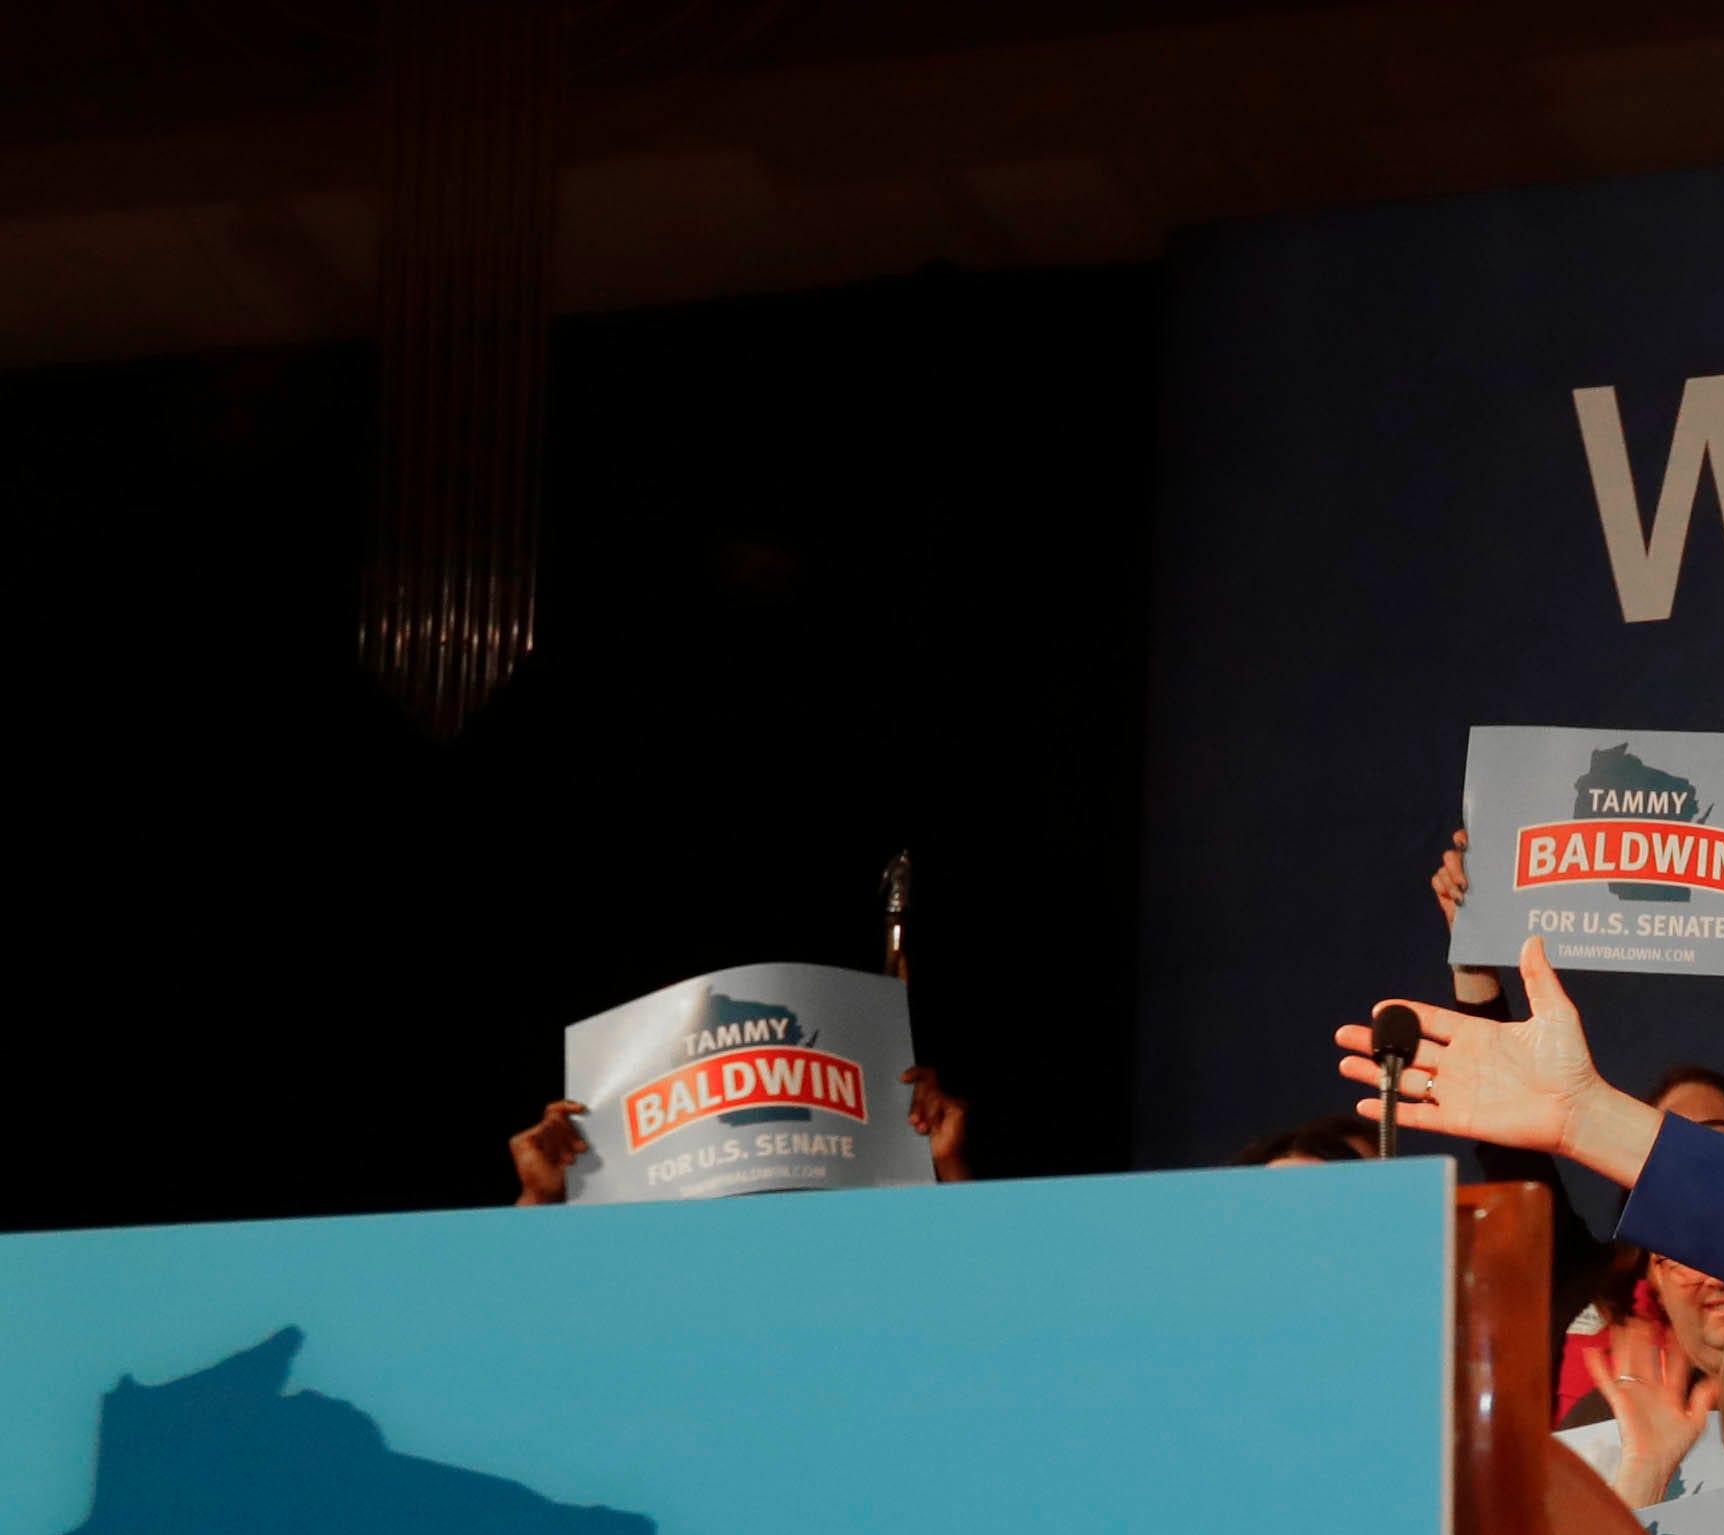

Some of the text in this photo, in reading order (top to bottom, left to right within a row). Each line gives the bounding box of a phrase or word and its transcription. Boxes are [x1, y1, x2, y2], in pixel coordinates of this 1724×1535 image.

[1589, 788, 1688, 814] TAMMY
[1527, 909, 1575, 932] FOR
[1582, 912, 1629, 936] U.S.
[1557, 944, 1696, 963] TAMMYBALDWIN.COM
[682, 1018, 790, 1057] TAMMY
[633, 1057, 857, 1136] BALDWIN
[647, 1131, 855, 1185] FOR U.S. SENATE
